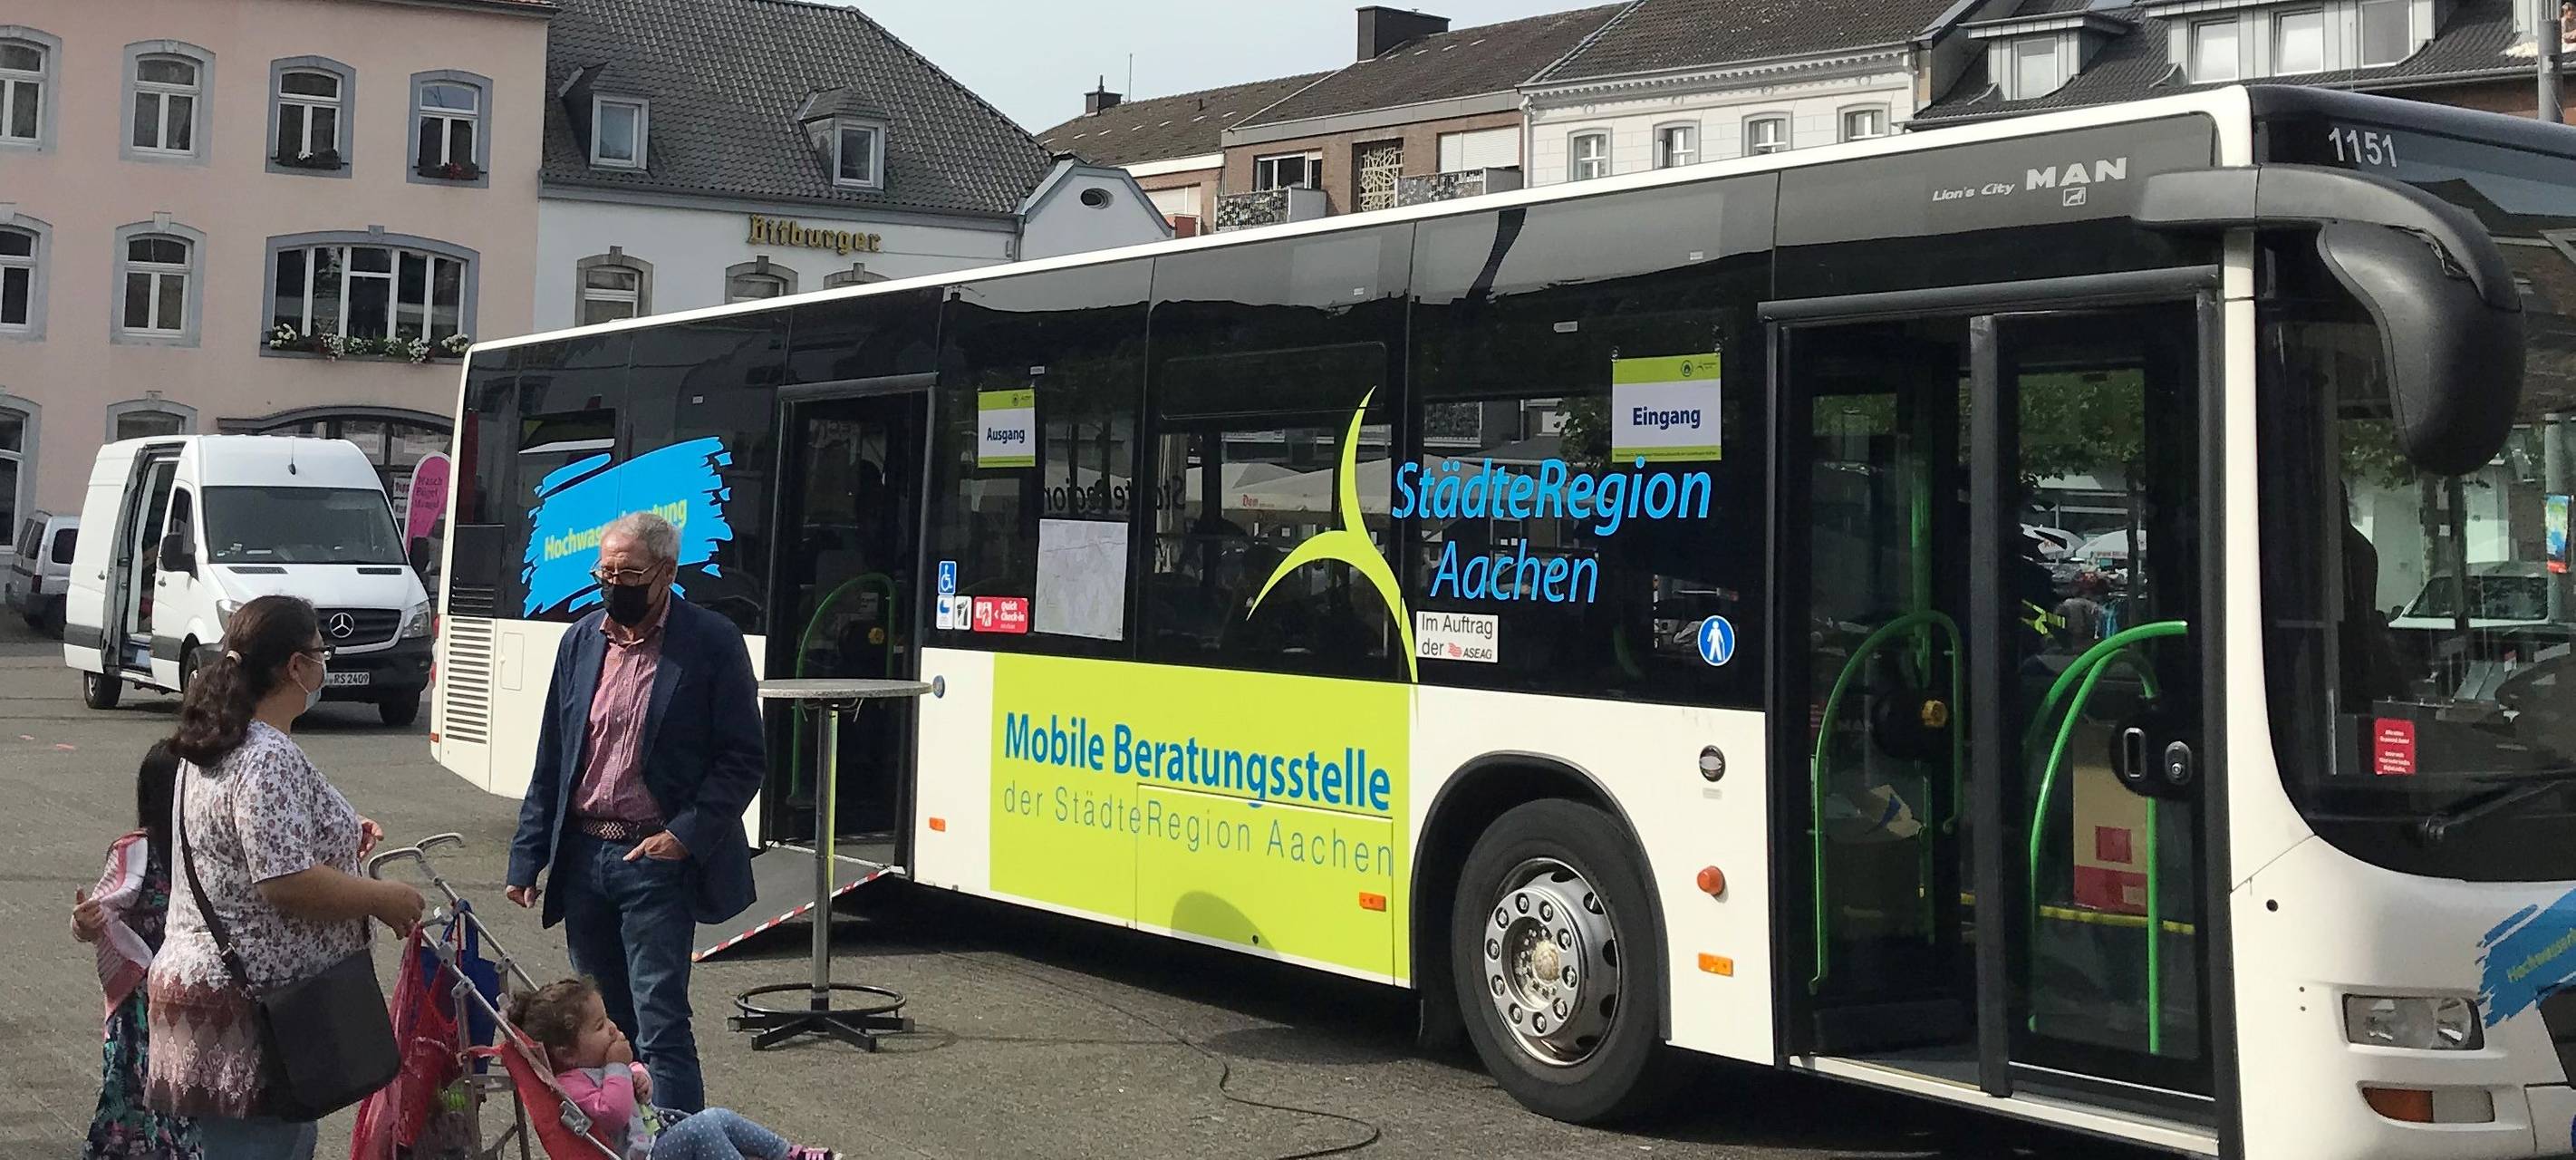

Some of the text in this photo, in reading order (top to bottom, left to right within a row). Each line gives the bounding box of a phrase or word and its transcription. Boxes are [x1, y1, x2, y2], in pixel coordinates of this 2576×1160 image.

[2329, 127, 2398, 168] 1151
[1932, 158, 2127, 201] Lion's City MAN
[748, 214, 883, 255] Bitburger
[987, 428, 1025, 444] Ausgang
[1633, 406, 1701, 430] Eingang
[1392, 456, 1712, 536] StädteRegion
[1430, 538, 1598, 604] Aachen
[1000, 601, 1018, 612] Quick
[1422, 614, 1493, 640] Im Auftrag
[1422, 638, 1492, 660] der ASEAG
[1005, 711, 1391, 811] Mobile Beratungsstelle
[1004, 780, 1393, 876] der StädteRegion Aachen
